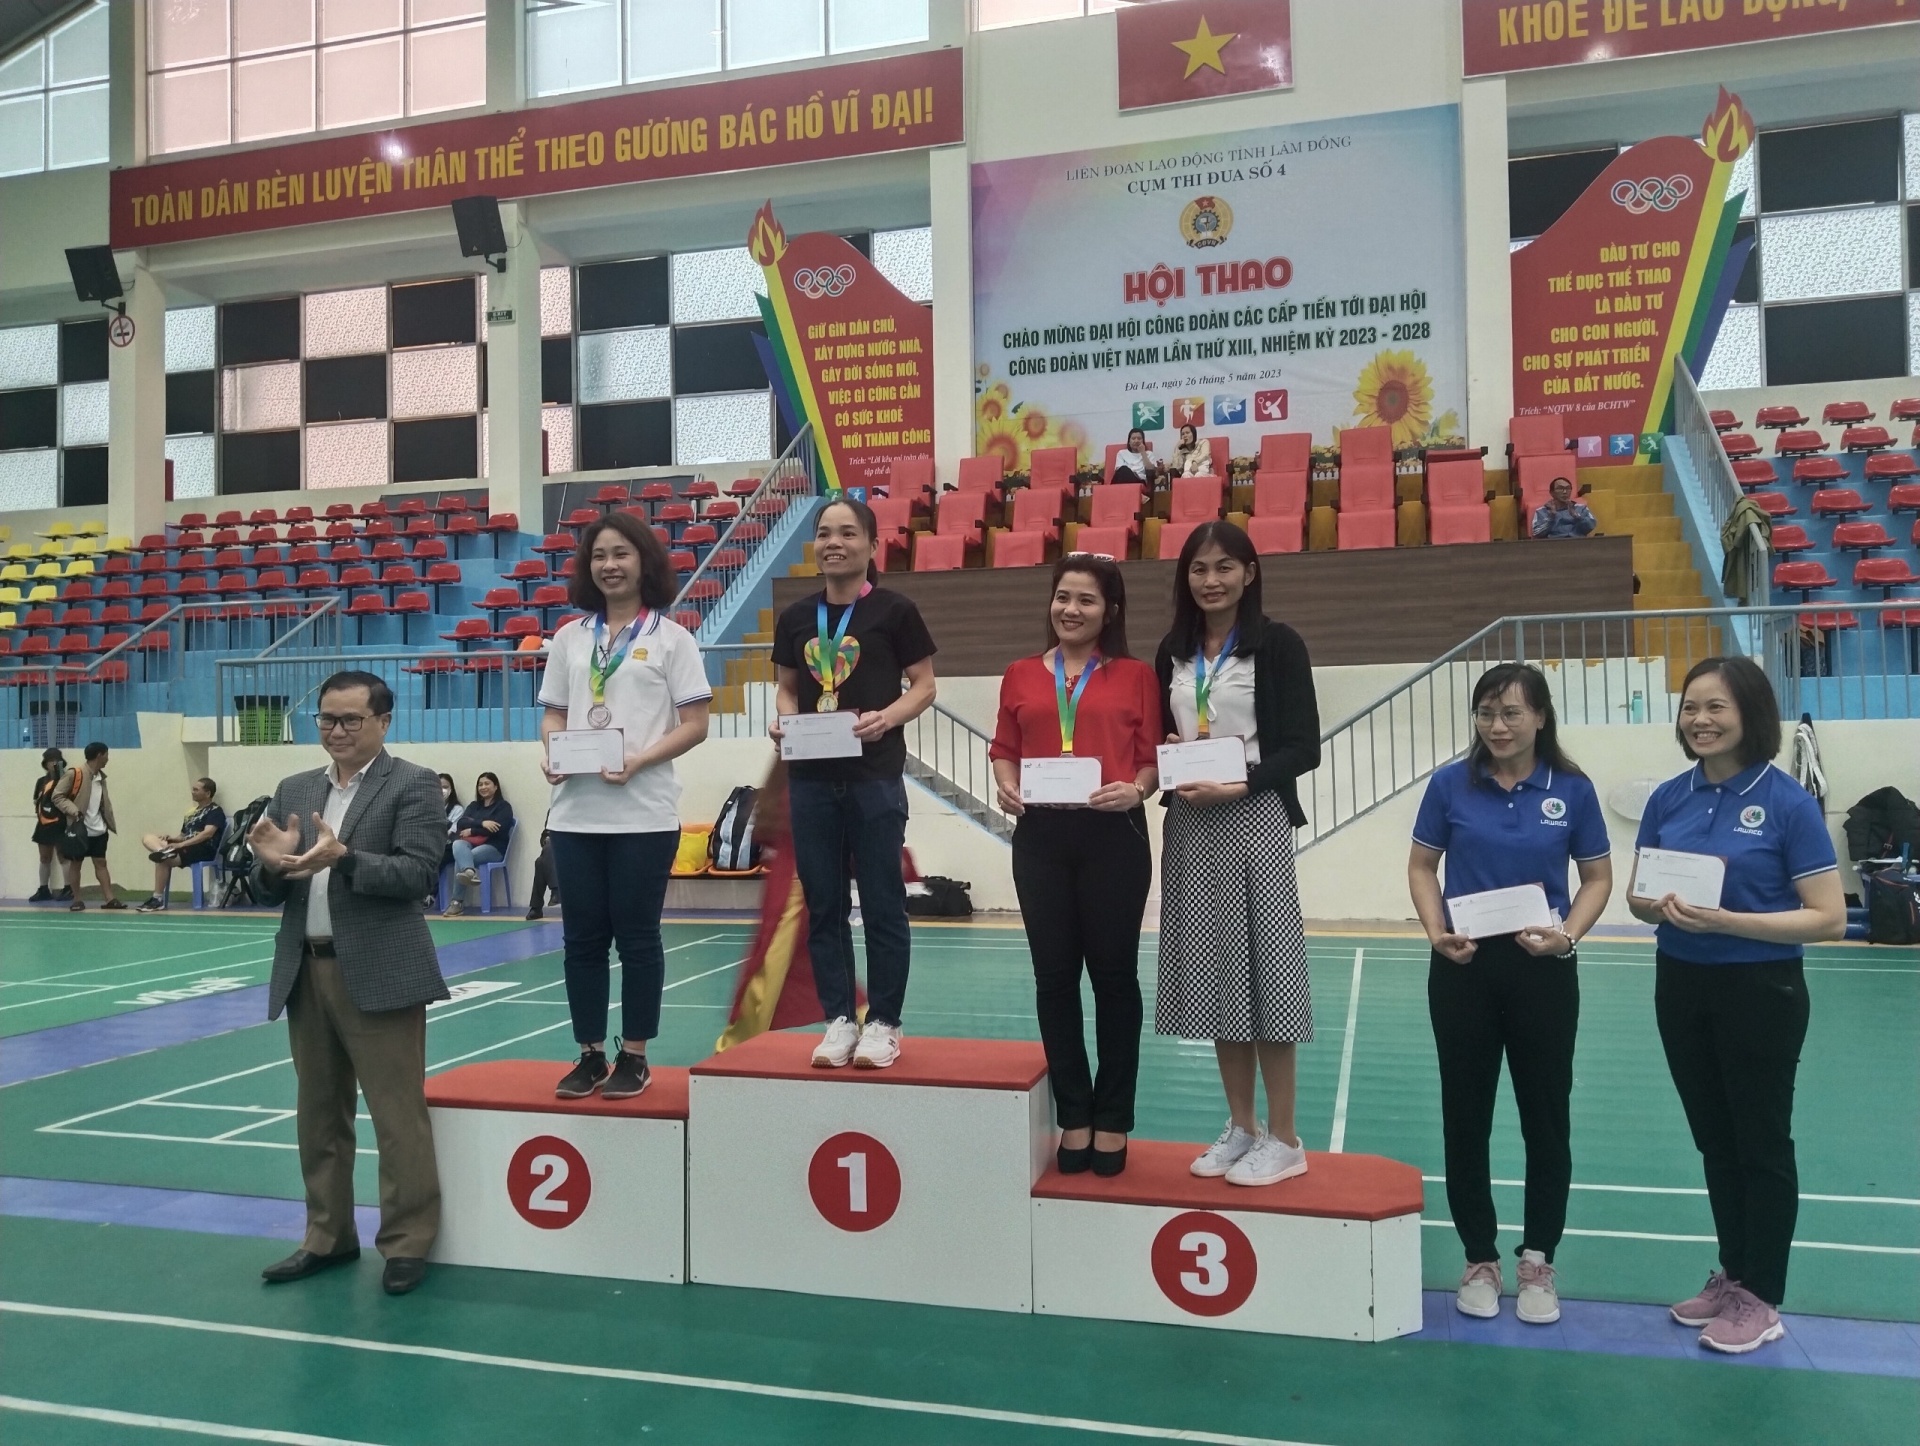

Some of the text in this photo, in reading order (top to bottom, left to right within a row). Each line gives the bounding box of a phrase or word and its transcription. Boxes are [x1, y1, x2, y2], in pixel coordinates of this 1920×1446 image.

[131, 86, 934, 228] TOÀN DÂN RÈN LUYỆN THÂN THỂ THEO GƯƠNG BÁC HỒ VĨ ĐẠI!
[1065, 165, 1100, 182] LIÊN
[1103, 159, 1144, 178] ĐOÀN
[1148, 157, 1177, 172] LAO
[1181, 150, 1225, 169] ĐỘNG
[1270, 139, 1303, 158] LÂM
[1307, 133, 1352, 153] ĐỒNG
[1127, 159, 1287, 196] CỤM THI ĐUA SỐ 4
[1599, 241, 1680, 263] ĐẦU TƯ CHO
[1123, 255, 1293, 307] HỘI THAO
[1548, 265, 1671, 293] THỂ DỤC THỂ THAO
[1595, 291, 1664, 315] LÀ ĐẦU TƯ
[828, 320, 846, 338] GÌN
[849, 318, 870, 335] DÂN
[872, 314, 897, 333] CHỦ,
[1002, 287, 1427, 350] CHÀO MỪNG ĐẠI HỘI CÔNG ĐOÀN CÁC CẤP TIẾN TỚI ĐẠI HỘI
[1550, 317, 1659, 344] CHO CON NGƯỜI,
[814, 337, 923, 362] XÂY DỰNG NƯỚC NHÀ,
[1008, 350, 1047, 378] CÔNG
[1050, 347, 1089, 374] ĐOÀN
[1092, 345, 1122, 372] VIỆT
[1125, 345, 1159, 367] NAM
[1162, 337, 1193, 364] LẦN
[1196, 333, 1226, 360] THỨ
[1228, 337, 1258, 358] XIII,
[1261, 329, 1312, 355] NHIỆM
[1315, 325, 1336, 348] KỲ
[1339, 328, 1377, 347] 2023
[1392, 322, 1431, 342] 2028
[1522, 341, 1650, 371] CHO SỰ PHÁT TRIỂN
[821, 359, 919, 383] GÂY ĐỜI SỐNG MỚI,
[1124, 368, 1282, 392] Đà Lạt, ngày 26 tháng 5 năm 2023
[1543, 369, 1644, 396] CỦA ĐẤT NƯỚC.
[828, 380, 921, 406] VIỆC GÌ CŨNG CẦN
[835, 404, 903, 427] CÓ SỨC KHOẺ
[1518, 405, 1541, 416] Trích:
[1581, 402, 1596, 412] của
[842, 426, 931, 449] MỚI THÀNH CÔNG
[1540, 818, 1568, 827] LAWACO
[1733, 826, 1763, 836] LAWACO
[528, 1153, 569, 1214] 2
[836, 1152, 868, 1213] 1
[1179, 1231, 1230, 1297] 3
